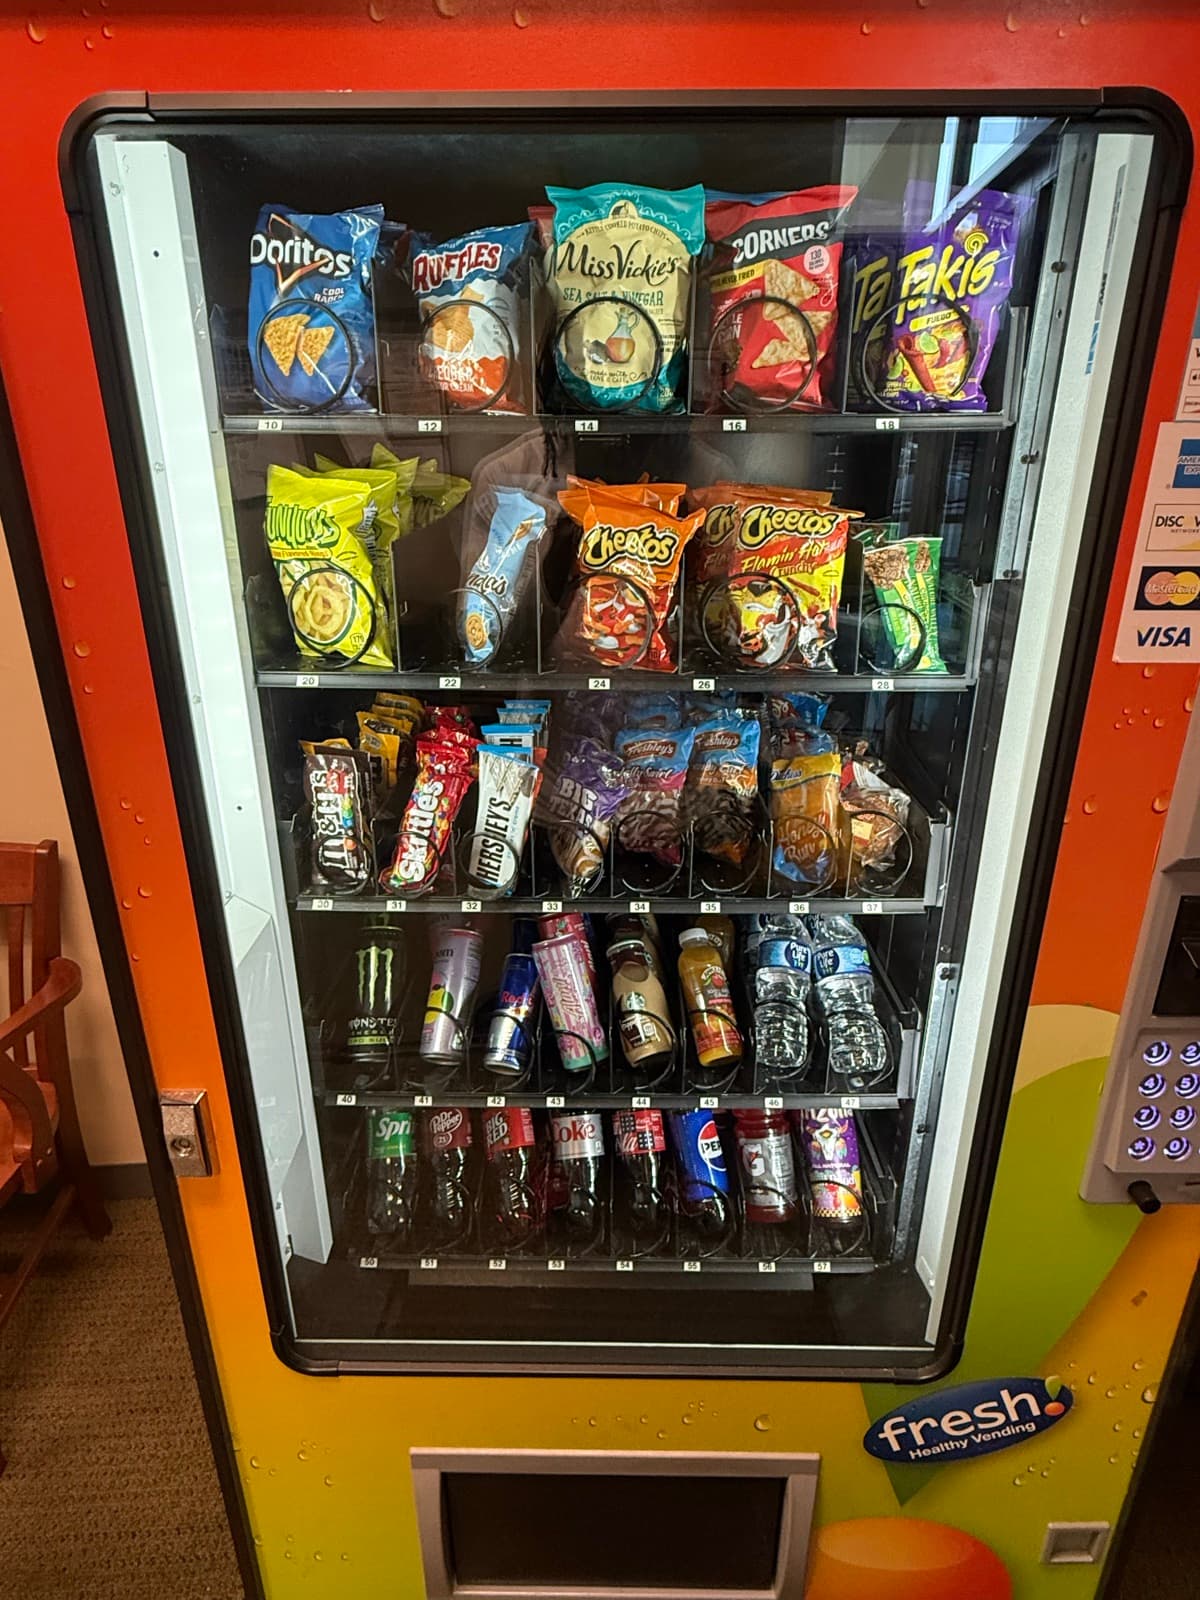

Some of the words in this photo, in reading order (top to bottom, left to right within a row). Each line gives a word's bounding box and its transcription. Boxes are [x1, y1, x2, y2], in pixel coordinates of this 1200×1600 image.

[606, 221, 628, 231] COOKED
[628, 221, 649, 231] POTATO
[732, 221, 830, 264] CORNERS
[250, 233, 352, 278] Doritos
[810, 249, 822, 260] 130
[412, 242, 502, 294] RUFFLES
[557, 241, 615, 280] Miss
[609, 239, 682, 287] Vickie's
[738, 269, 755, 280] FRIED
[894, 232, 1001, 325] Takis
[322, 287, 345, 296] COOL
[563, 288, 582, 302] SEA
[926, 311, 952, 325] FUEGO
[265, 421, 278, 430] 10
[424, 422, 437, 432] 12
[580, 422, 594, 431] 14
[728, 422, 742, 431] 16
[882, 421, 895, 430] 18
[737, 504, 839, 550] Cheetos
[583, 525, 677, 570] Cheetos
[741, 546, 797, 573] Flamin'
[798, 539, 828, 559] Hot
[1137, 627, 1190, 647] VISA
[302, 677, 315, 686] 20
[444, 679, 456, 687] 22
[594, 680, 606, 688] 24
[698, 681, 710, 690] 26
[877, 681, 889, 689] 28
[559, 778, 598, 811] BIG
[549, 796, 593, 829] TEXAS
[399, 780, 444, 882] Skittles
[477, 797, 512, 882] HERSHEY'S
[317, 900, 329, 908] 30
[391, 901, 402, 909] 31
[466, 902, 478, 910] 32
[634, 903, 645, 911] 34
[791, 942, 808, 954] Pure
[792, 949, 806, 962] Life
[1151, 1045, 1159, 1057] 1
[1186, 1045, 1197, 1057] 2
[1144, 1077, 1155, 1089] 4
[1181, 1077, 1191, 1089] 5
[341, 1096, 352, 1104] 40
[550, 1098, 560, 1106] 43
[768, 1099, 779, 1107] 46
[845, 1099, 855, 1107] 47
[439, 1111, 453, 1123] Dr
[1140, 1109, 1150, 1121] 7
[1175, 1109, 1186, 1121] 8
[432, 1113, 460, 1134] Pepper
[487, 1111, 504, 1132] BIG
[487, 1123, 508, 1146] RED
[553, 1121, 596, 1142] Coke
[1169, 1140, 1180, 1152] 0
[364, 1258, 374, 1266] 50
[425, 1258, 434, 1266] 51
[493, 1259, 502, 1267] 52
[551, 1260, 561, 1268] 53
[620, 1261, 629, 1269] 54
[688, 1262, 697, 1270] 55
[762, 1263, 772, 1271] 56
[817, 1263, 826, 1271] 57
[878, 1389, 1041, 1452] fresh
[909, 1438, 968, 1460] Healthy
[971, 1422, 1036, 1444] Vending
